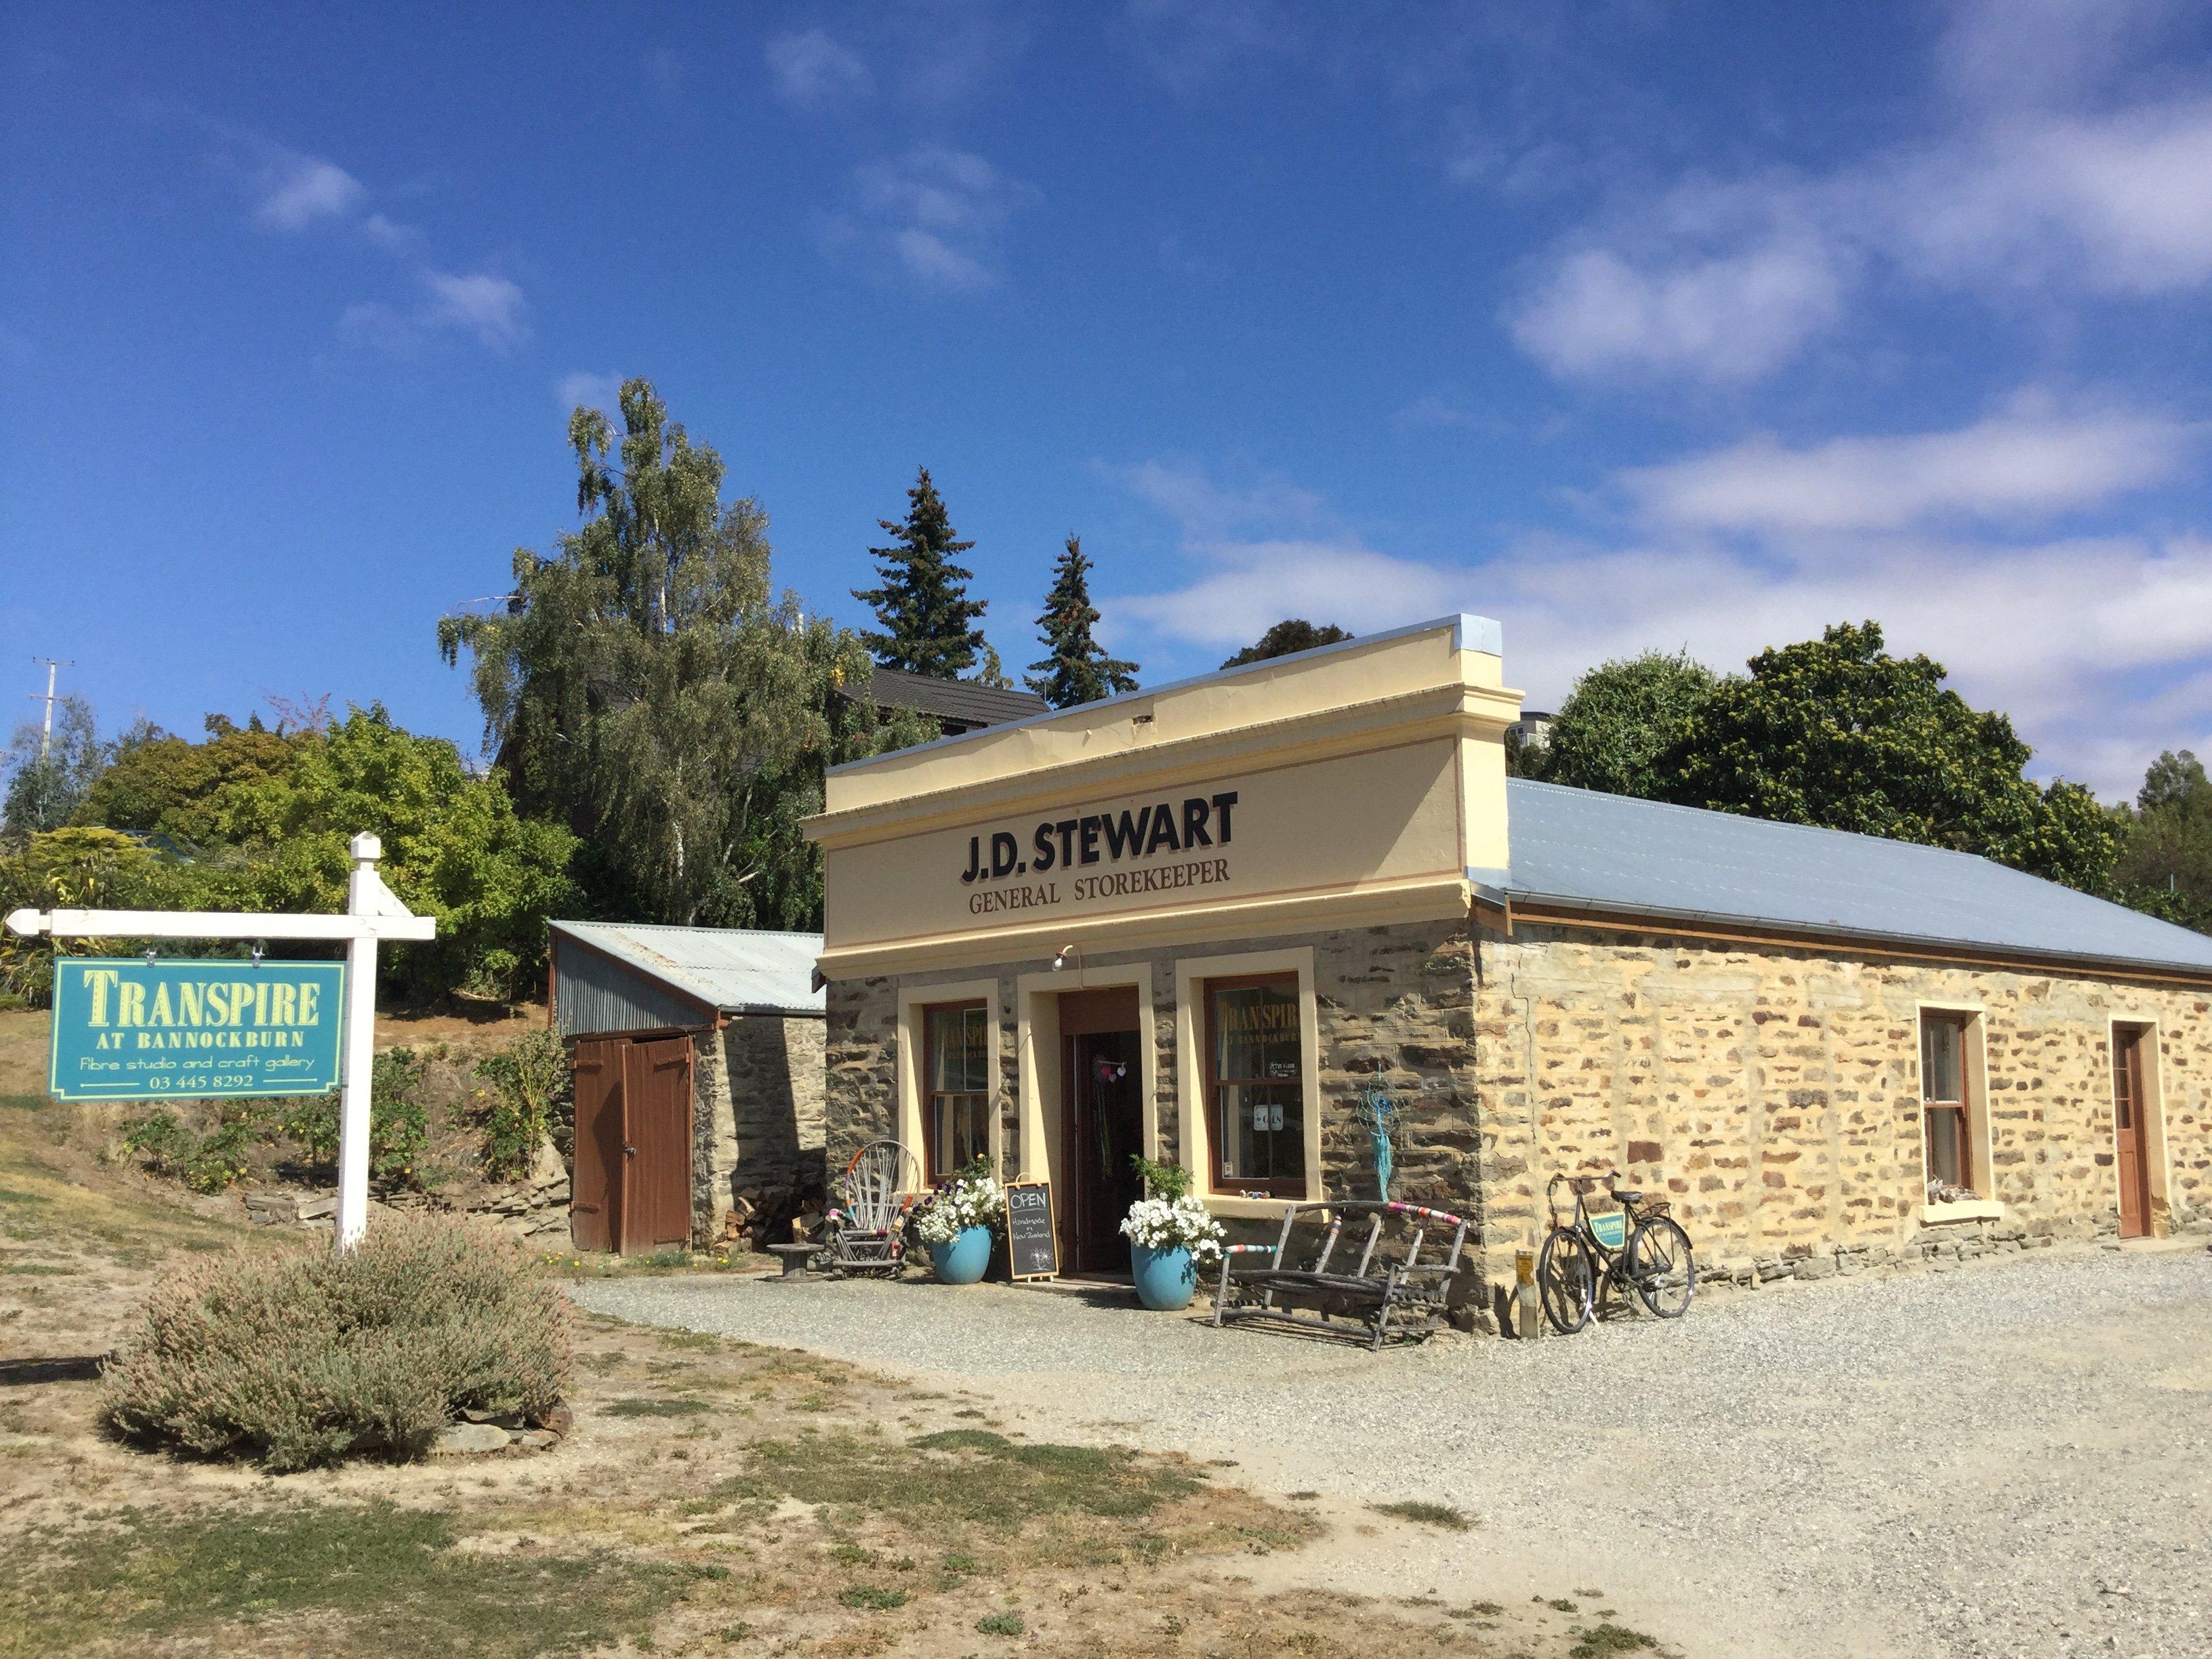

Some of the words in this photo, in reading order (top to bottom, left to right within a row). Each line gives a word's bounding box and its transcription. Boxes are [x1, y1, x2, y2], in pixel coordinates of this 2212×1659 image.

[969, 883, 1061, 914] GENERAL
[1074, 858, 1231, 901] STOREKEEPER
[83, 970, 321, 1027] TRANSPIRE
[96, 1032, 125, 1050] AT
[138, 1030, 304, 1049] BANNOCKBURN
[80, 1057, 120, 1071] Fibre
[127, 1056, 177, 1069] studio
[182, 1056, 212, 1069] and
[218, 1054, 260, 1069] craft
[265, 1054, 314, 1072] gallery
[150, 1076, 171, 1090] 03
[176, 1076, 207, 1089] 445
[213, 1075, 253, 1088] 8292
[1010, 1192, 1046, 1208] OPEN
